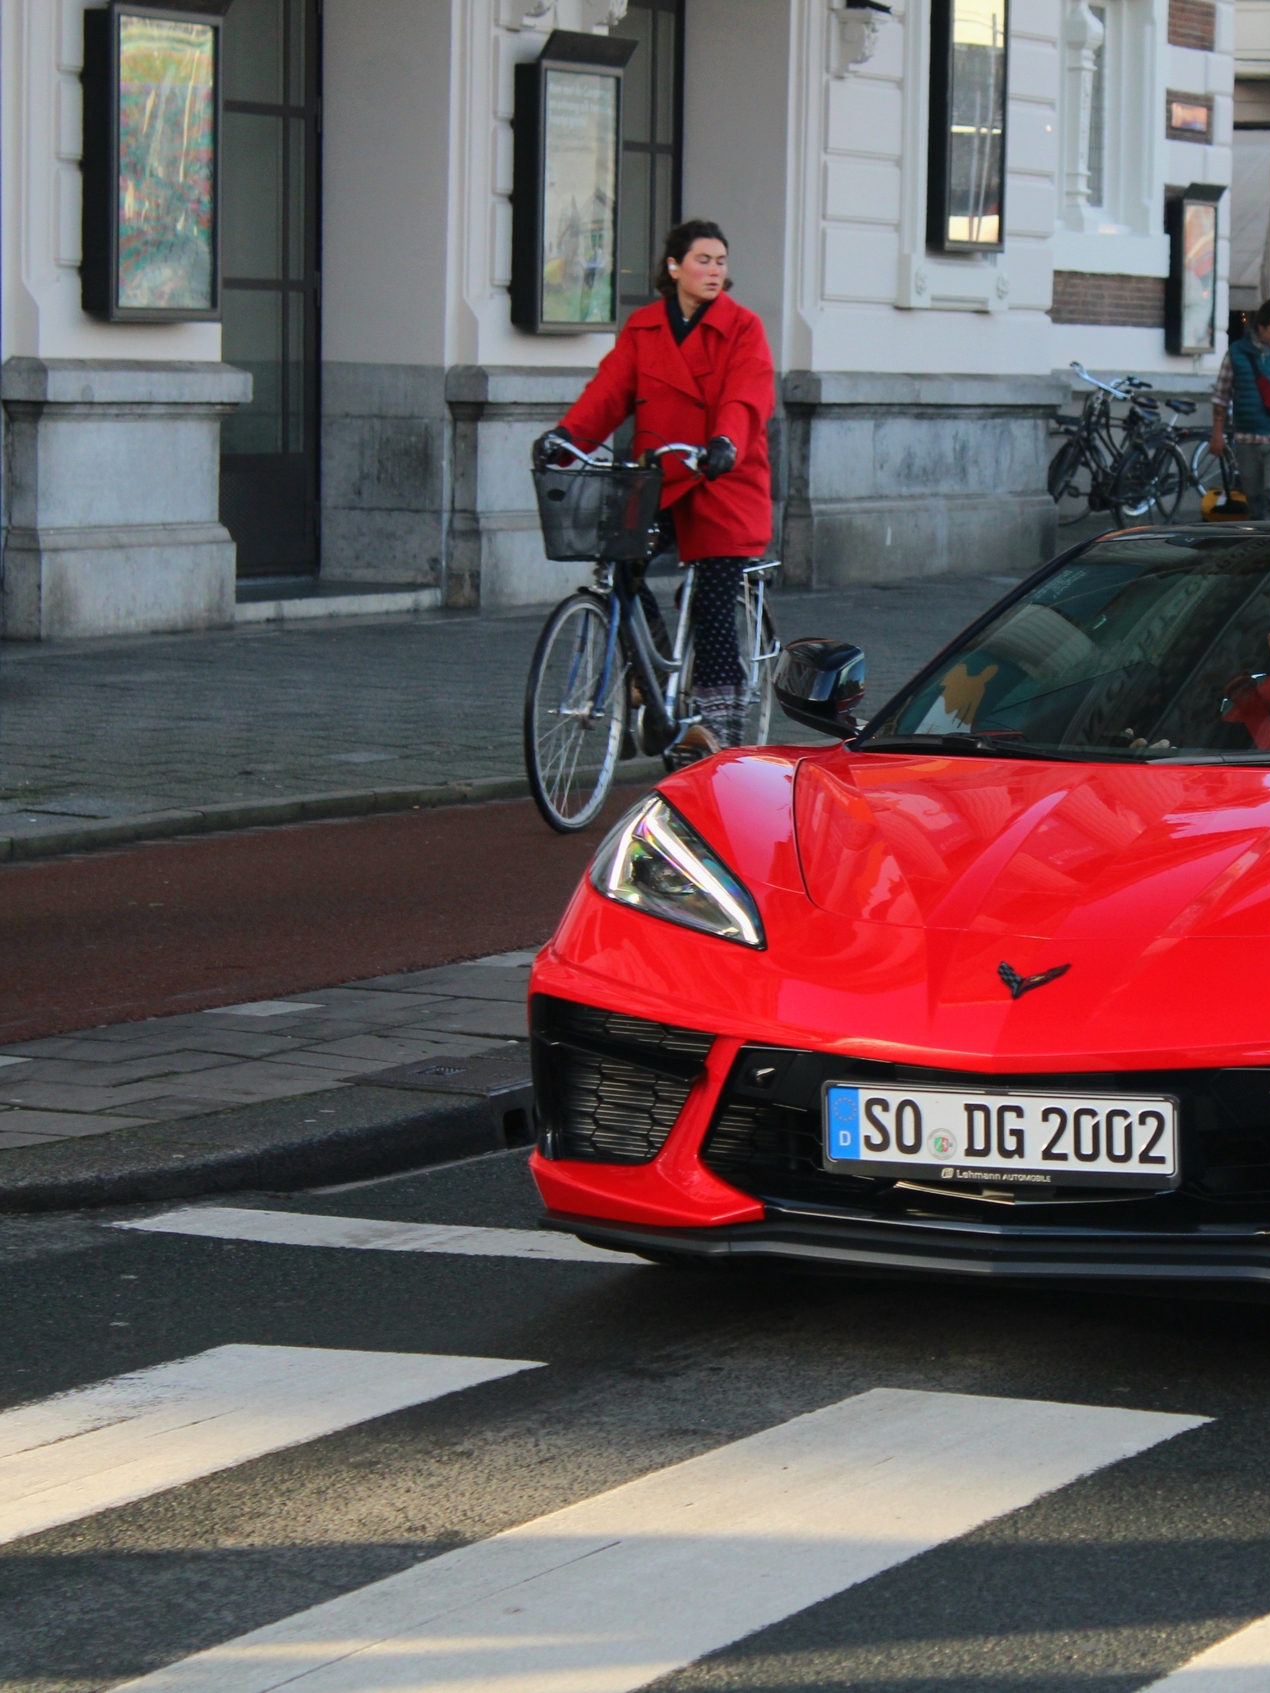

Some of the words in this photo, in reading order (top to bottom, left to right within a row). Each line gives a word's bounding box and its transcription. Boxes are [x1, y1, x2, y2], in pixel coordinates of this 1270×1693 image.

[839, 1130, 852, 1146] D
[863, 1097, 923, 1155] SO
[963, 1103, 1025, 1159] DG
[1041, 1106, 1167, 1165] 2002
[956, 1169, 1001, 1181] Lehmann
